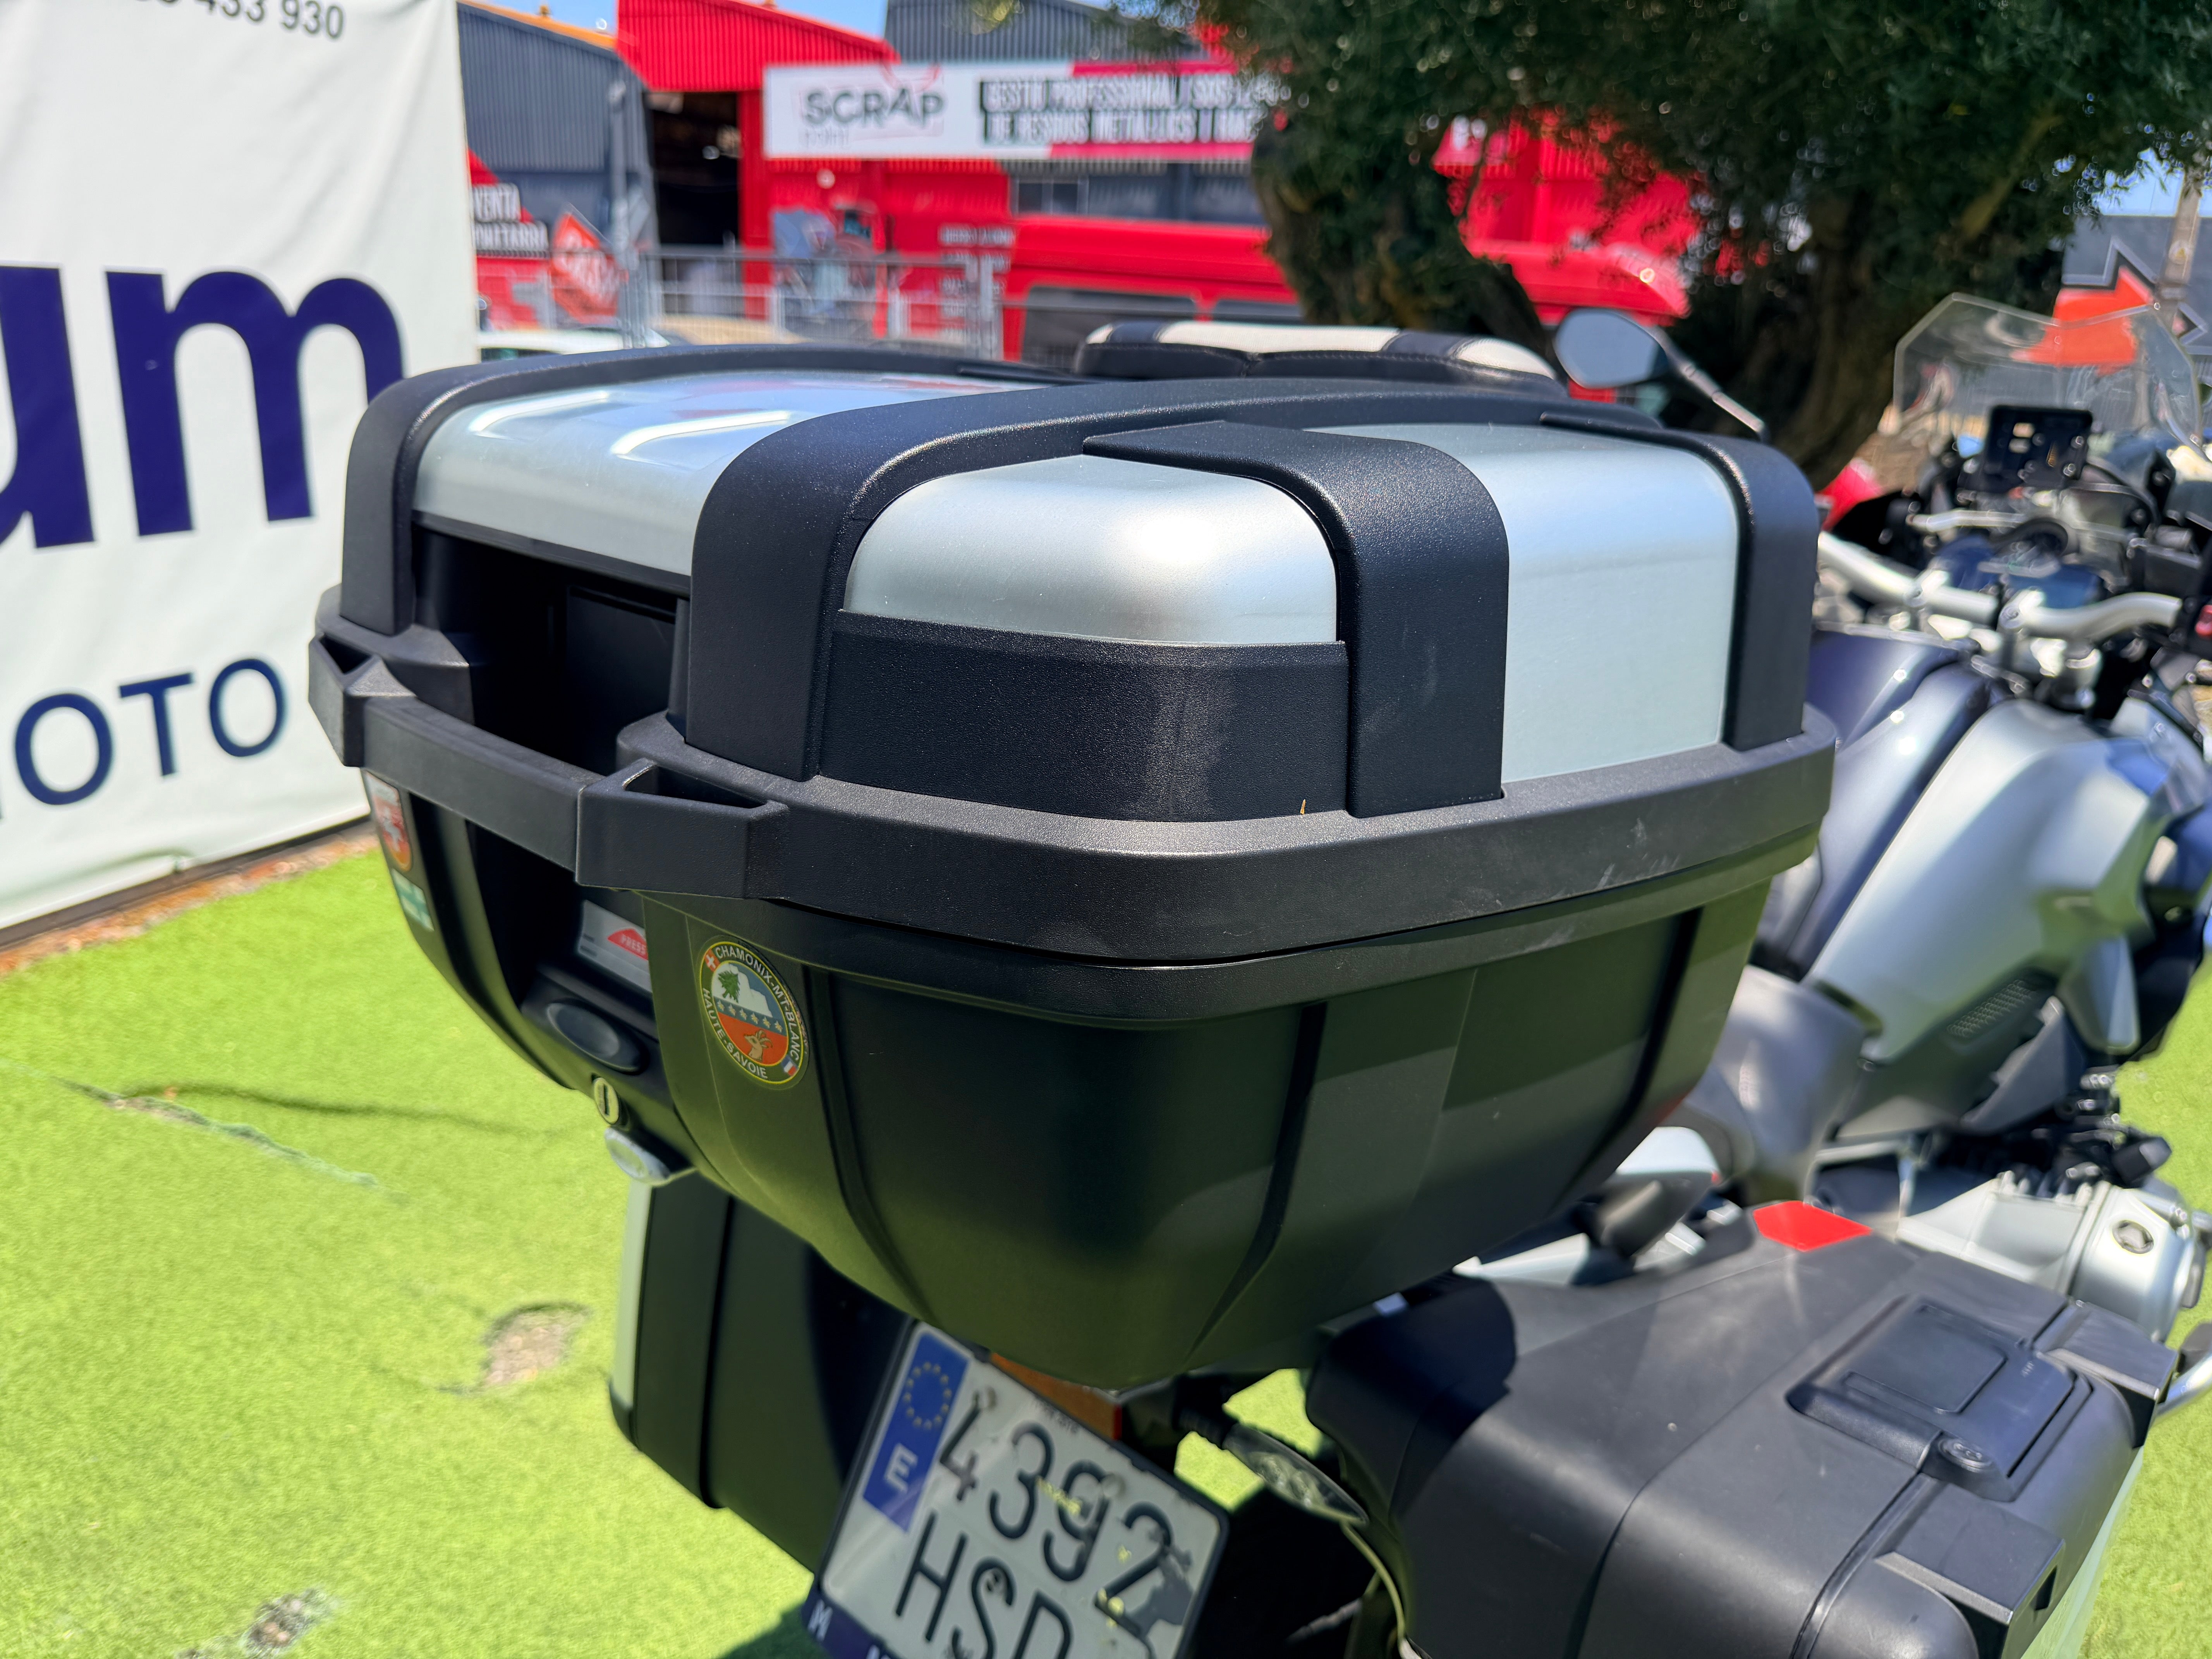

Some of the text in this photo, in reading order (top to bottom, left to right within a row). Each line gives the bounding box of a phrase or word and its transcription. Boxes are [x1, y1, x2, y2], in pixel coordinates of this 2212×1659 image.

[281, 0, 344, 39] 930
[806, 88, 945, 127] SCRAP
[0, 658, 287, 819] OTO
[883, 1442, 918, 1492] E
[939, 1388, 1175, 1659] 4392
